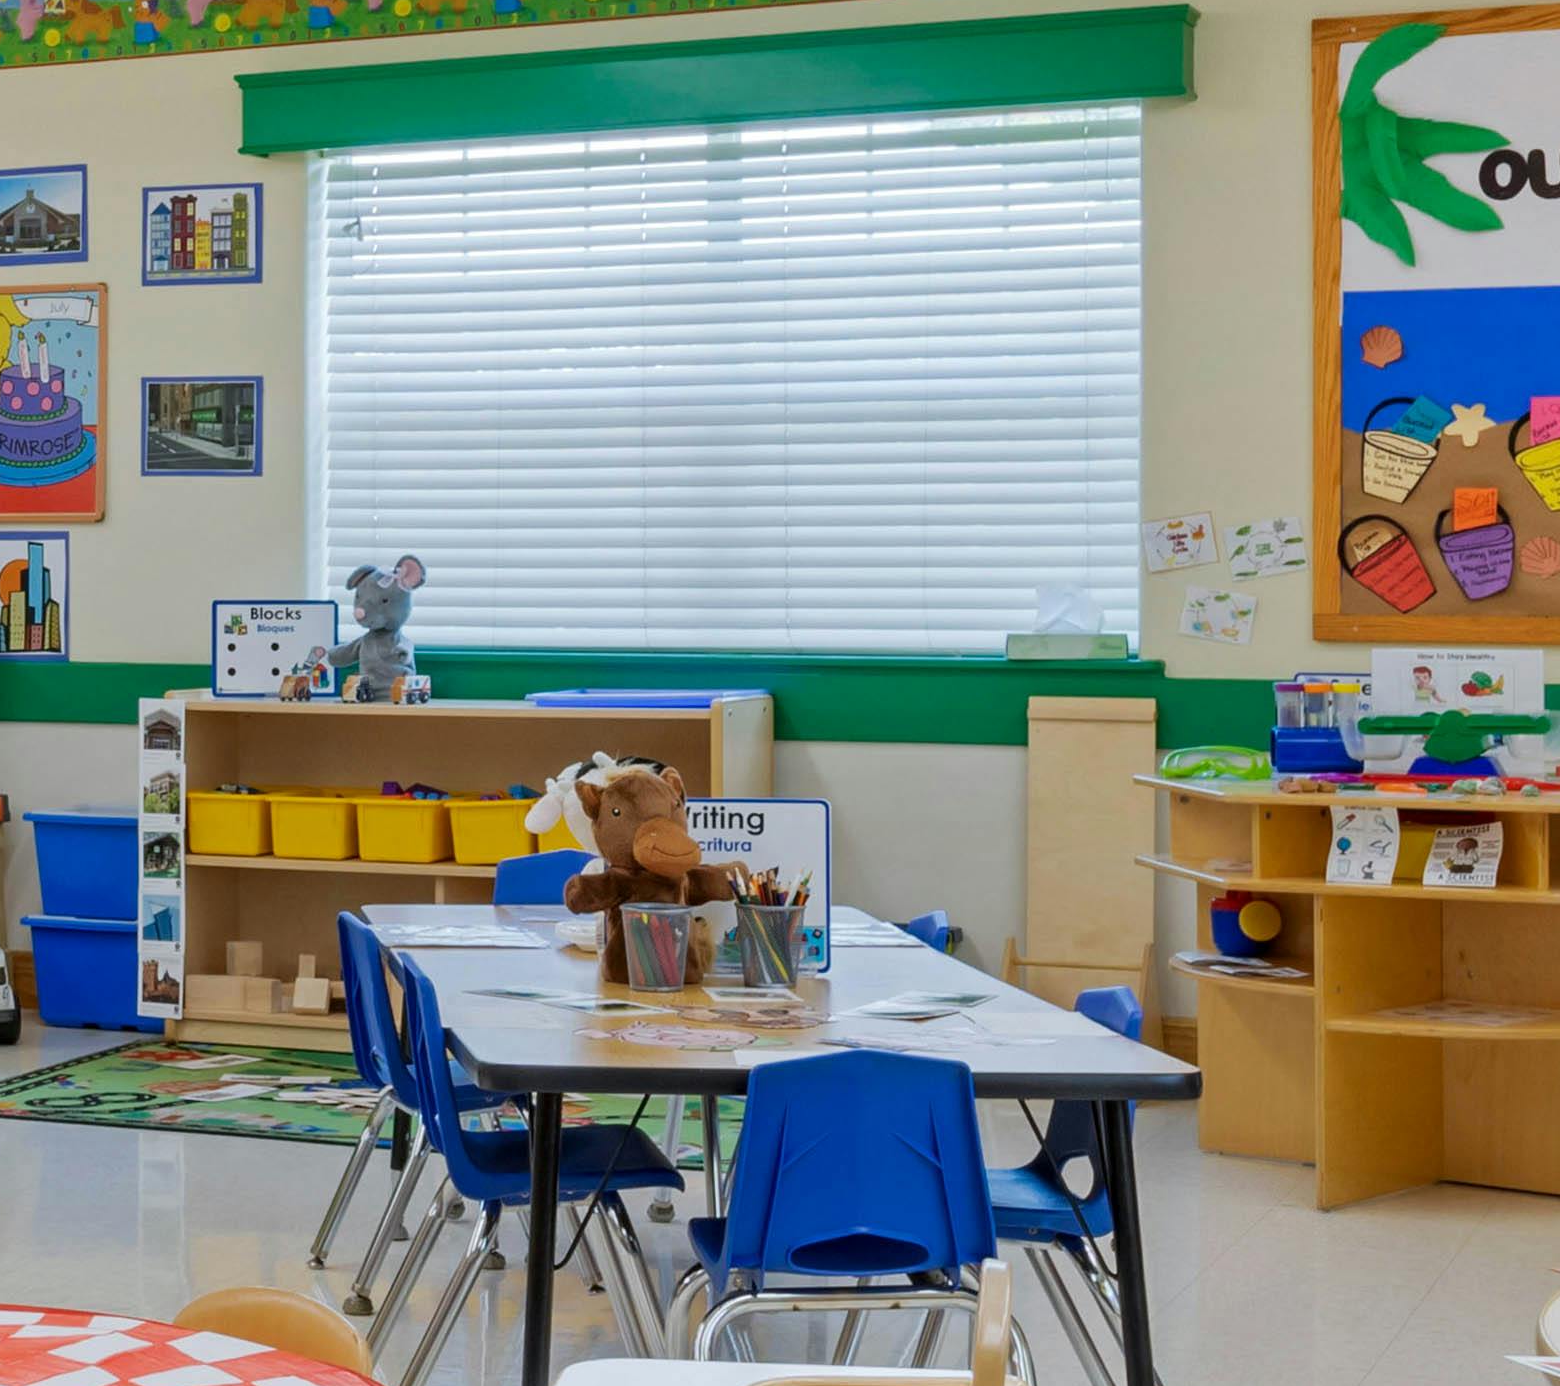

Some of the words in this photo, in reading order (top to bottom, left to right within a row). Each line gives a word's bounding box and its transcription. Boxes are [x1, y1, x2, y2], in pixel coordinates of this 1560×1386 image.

[50, 301, 70, 314] July
[250, 607, 302, 620] Blocks
[257, 624, 294, 634] Bloques
[686, 806, 765, 835] riting
[698, 837, 752, 852] critura
